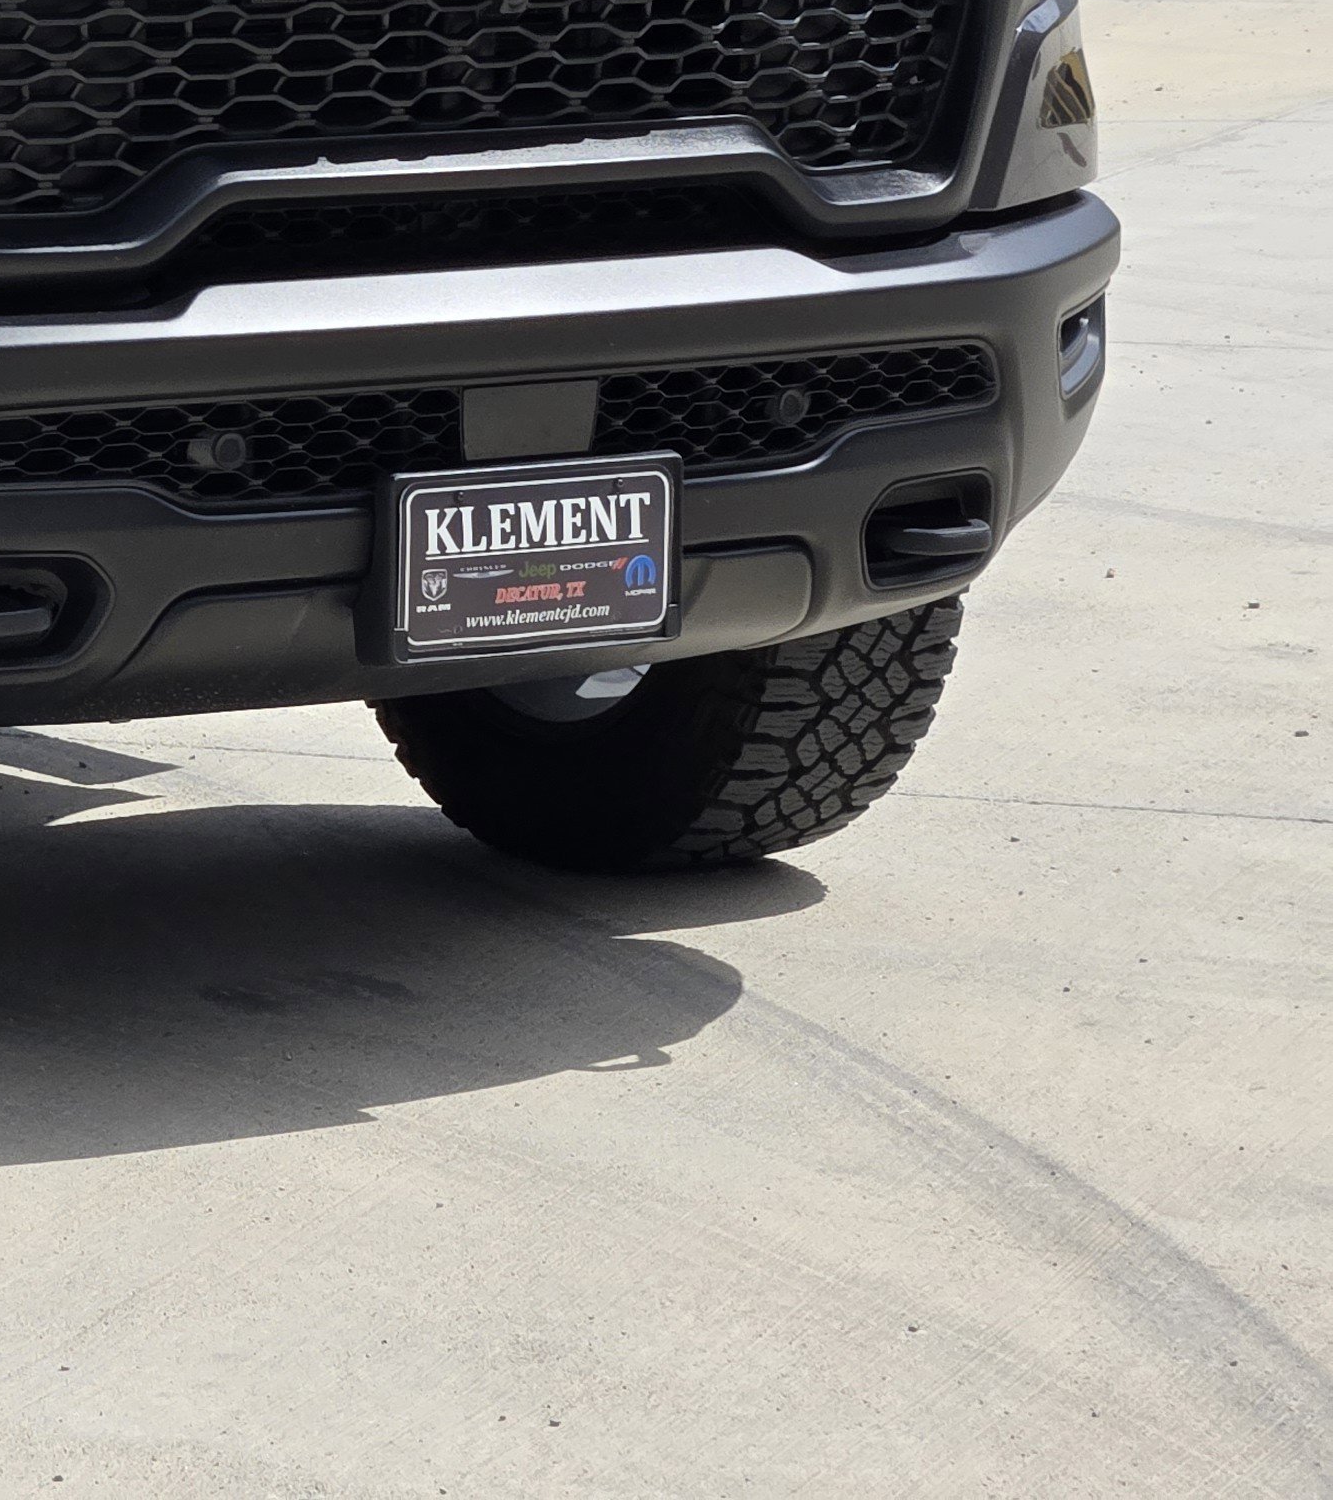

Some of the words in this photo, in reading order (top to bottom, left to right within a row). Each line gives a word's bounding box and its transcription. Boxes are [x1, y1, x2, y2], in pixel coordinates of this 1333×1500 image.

[425, 492, 651, 555] KLEMENT
[519, 561, 557, 579] Jeep
[495, 583, 564, 604] DECATUR,
[566, 581, 586, 598] TX
[416, 604, 451, 613] RAM
[466, 604, 610, 628] www.klementcjd.com
